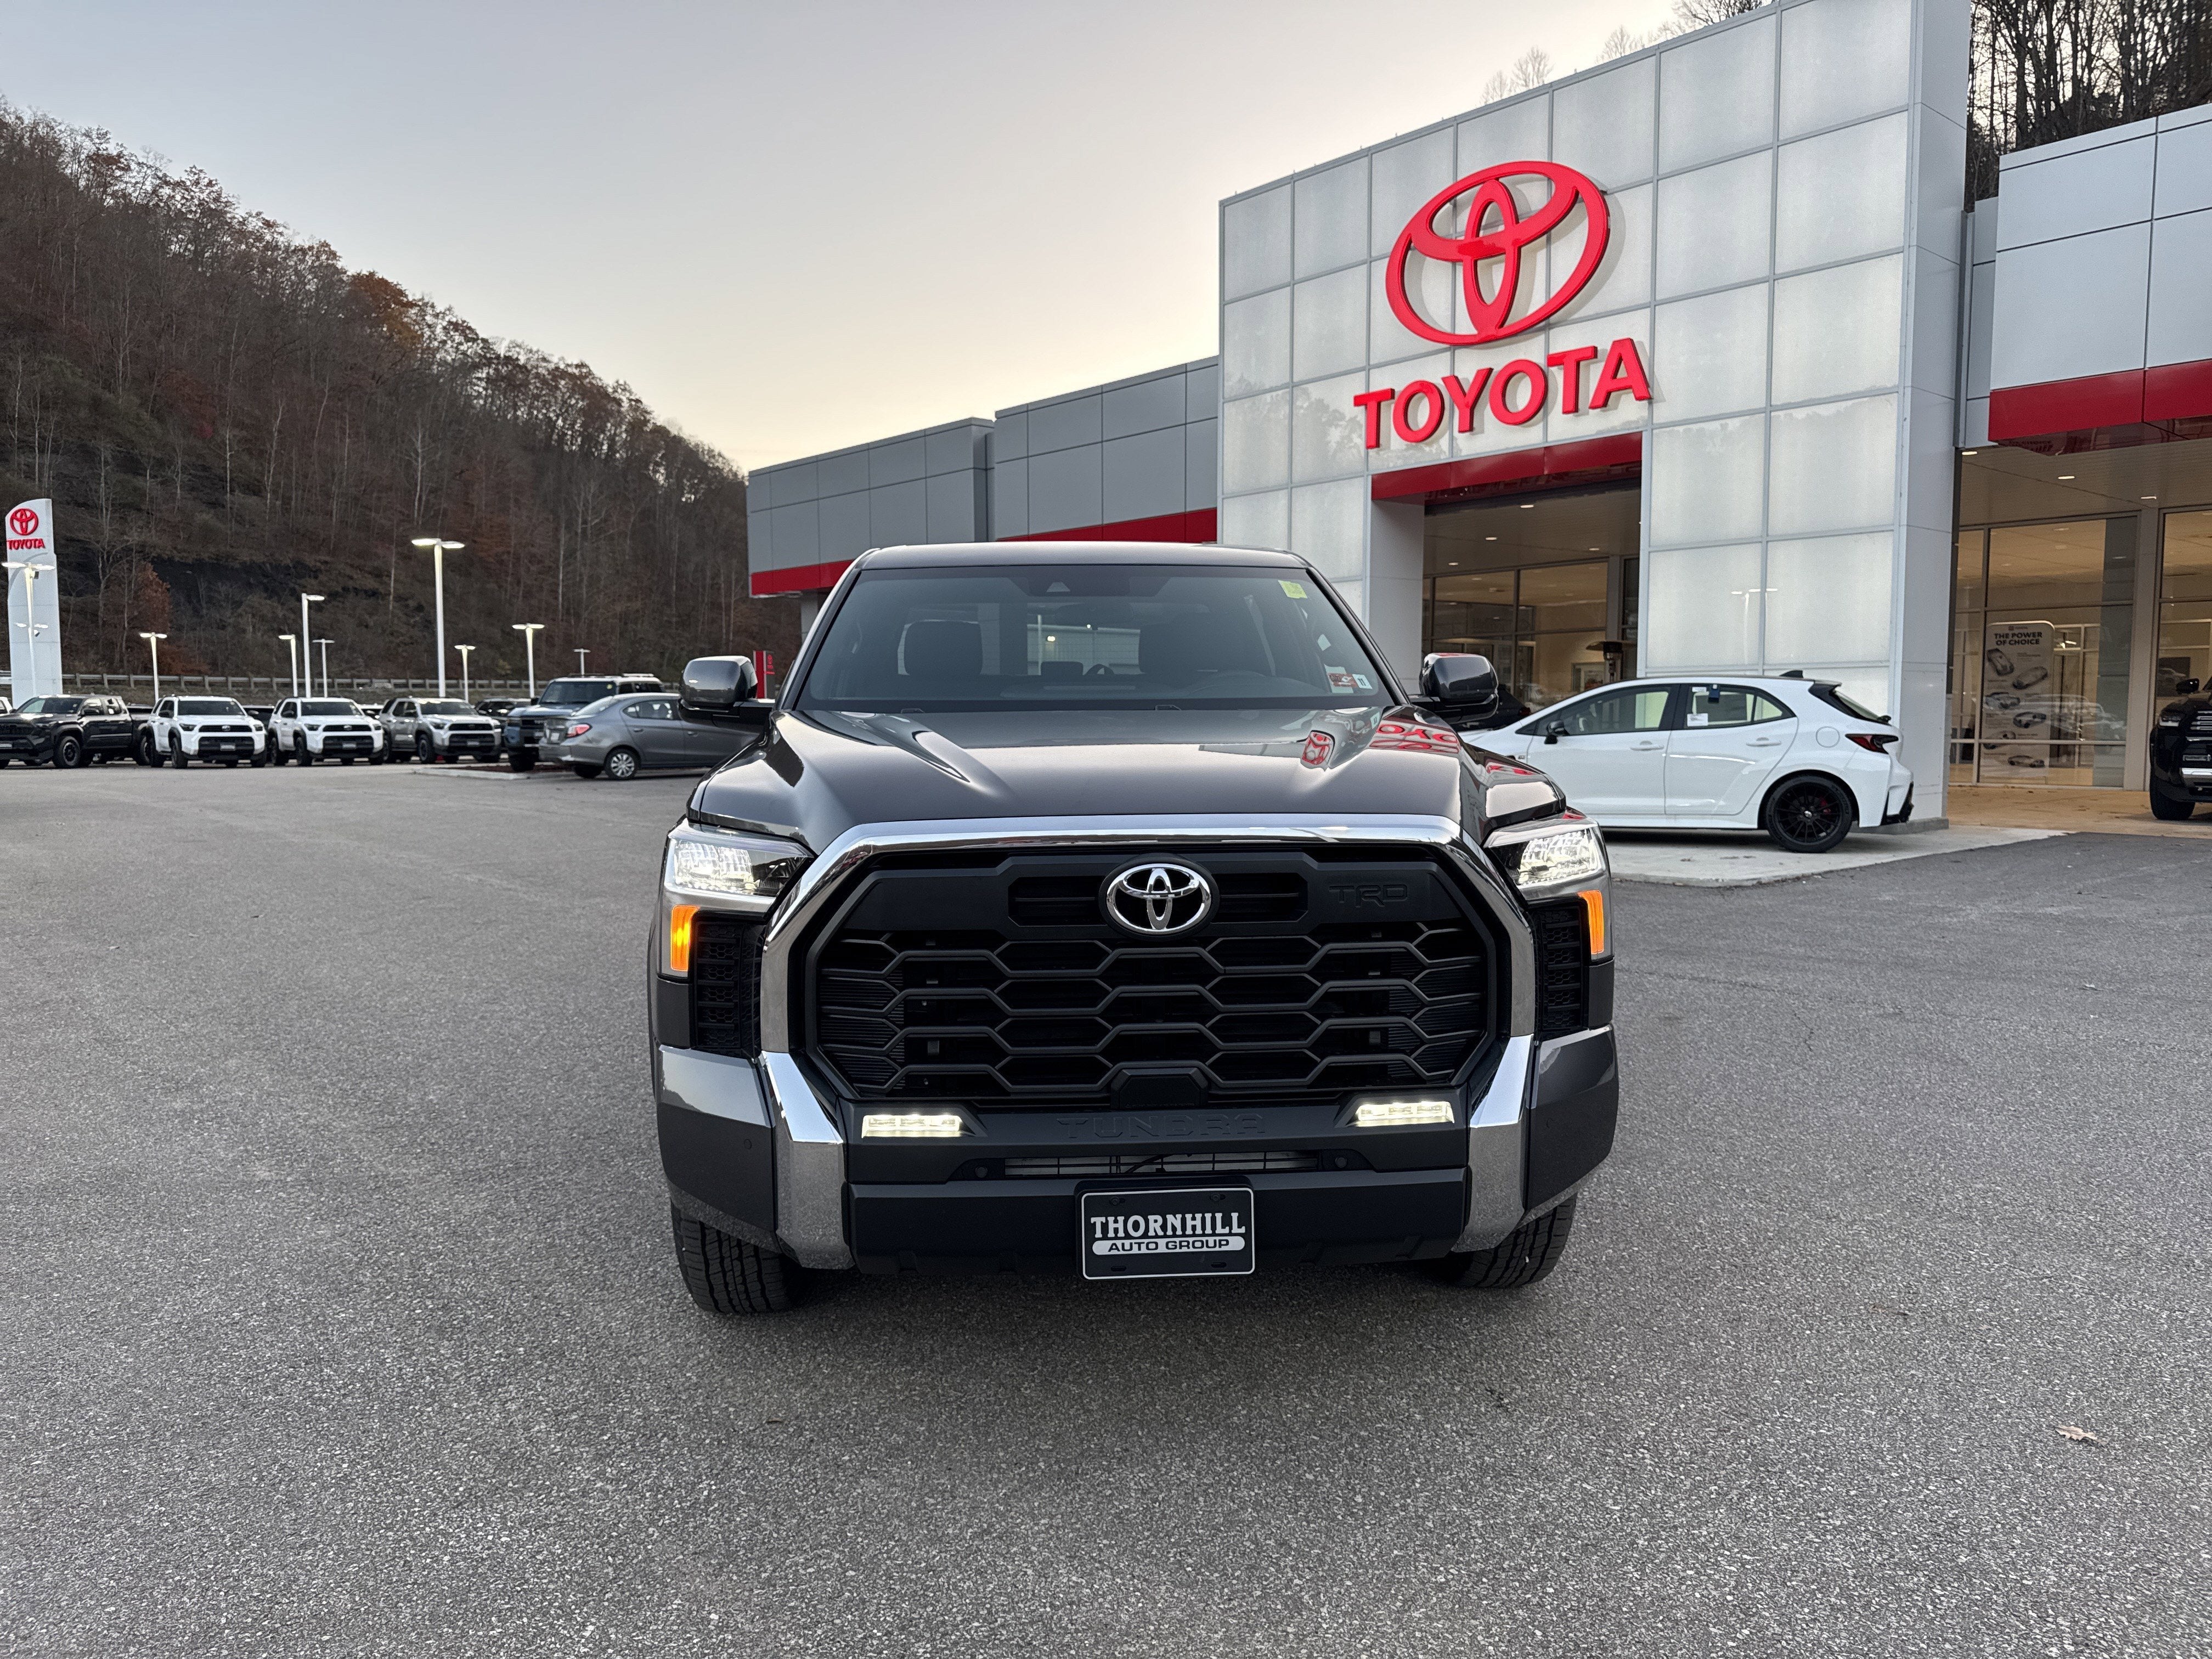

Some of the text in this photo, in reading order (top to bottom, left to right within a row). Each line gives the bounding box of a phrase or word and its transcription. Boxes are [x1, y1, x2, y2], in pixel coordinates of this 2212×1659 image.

[1353, 337, 1652, 450] TOYOTA
[7, 538, 46, 551] TOYOTA
[1329, 884, 1408, 907] TRD
[1056, 1114, 1266, 1138] TUNDRA
[1090, 1212, 1246, 1239] THORNHILL
[1107, 1238, 1230, 1253] AUTO GROUP
